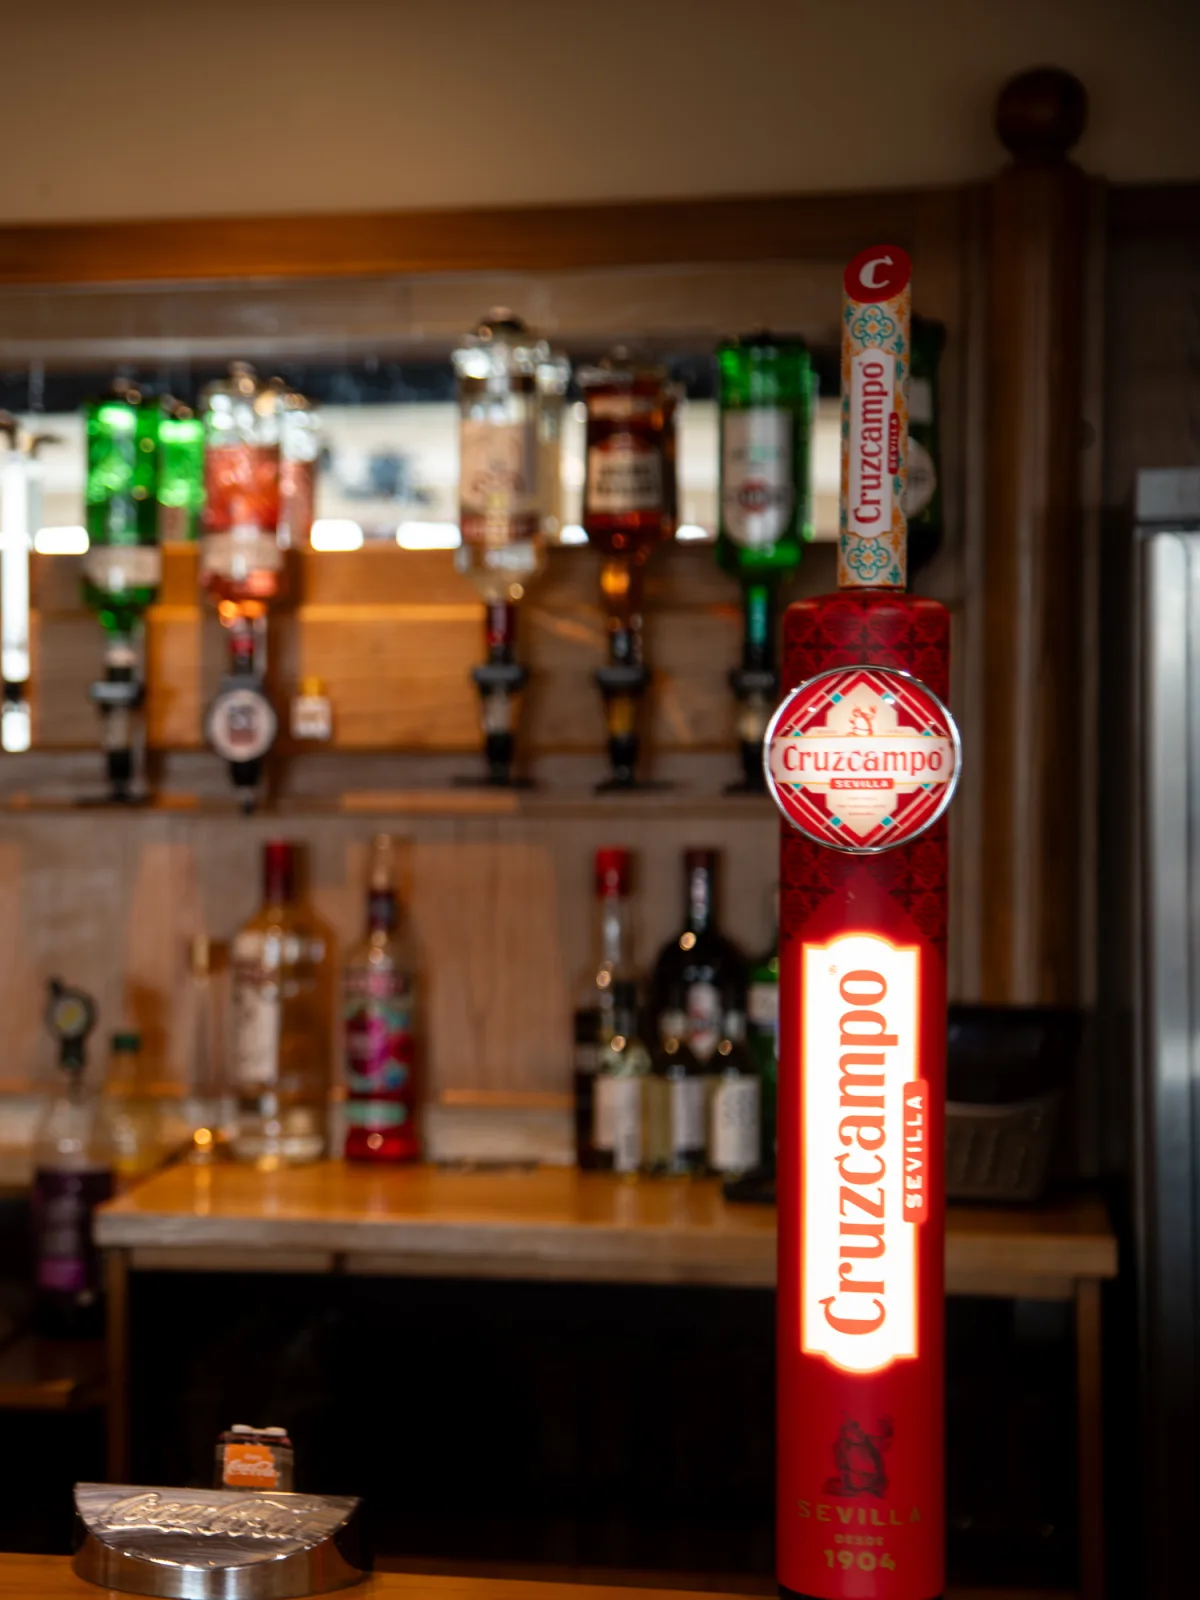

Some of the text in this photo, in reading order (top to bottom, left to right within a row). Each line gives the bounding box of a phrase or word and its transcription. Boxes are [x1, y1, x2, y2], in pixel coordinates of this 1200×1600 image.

[853, 362, 888, 525] Cruzcampo
[782, 744, 943, 776] Cruzcampo
[835, 779, 890, 788] SEVILLA
[818, 969, 899, 1336] Cruzcampo
[906, 1095, 924, 1209] SEVILLA
[797, 1500, 921, 1526] SEVILLA
[824, 1549, 896, 1572] 1904
